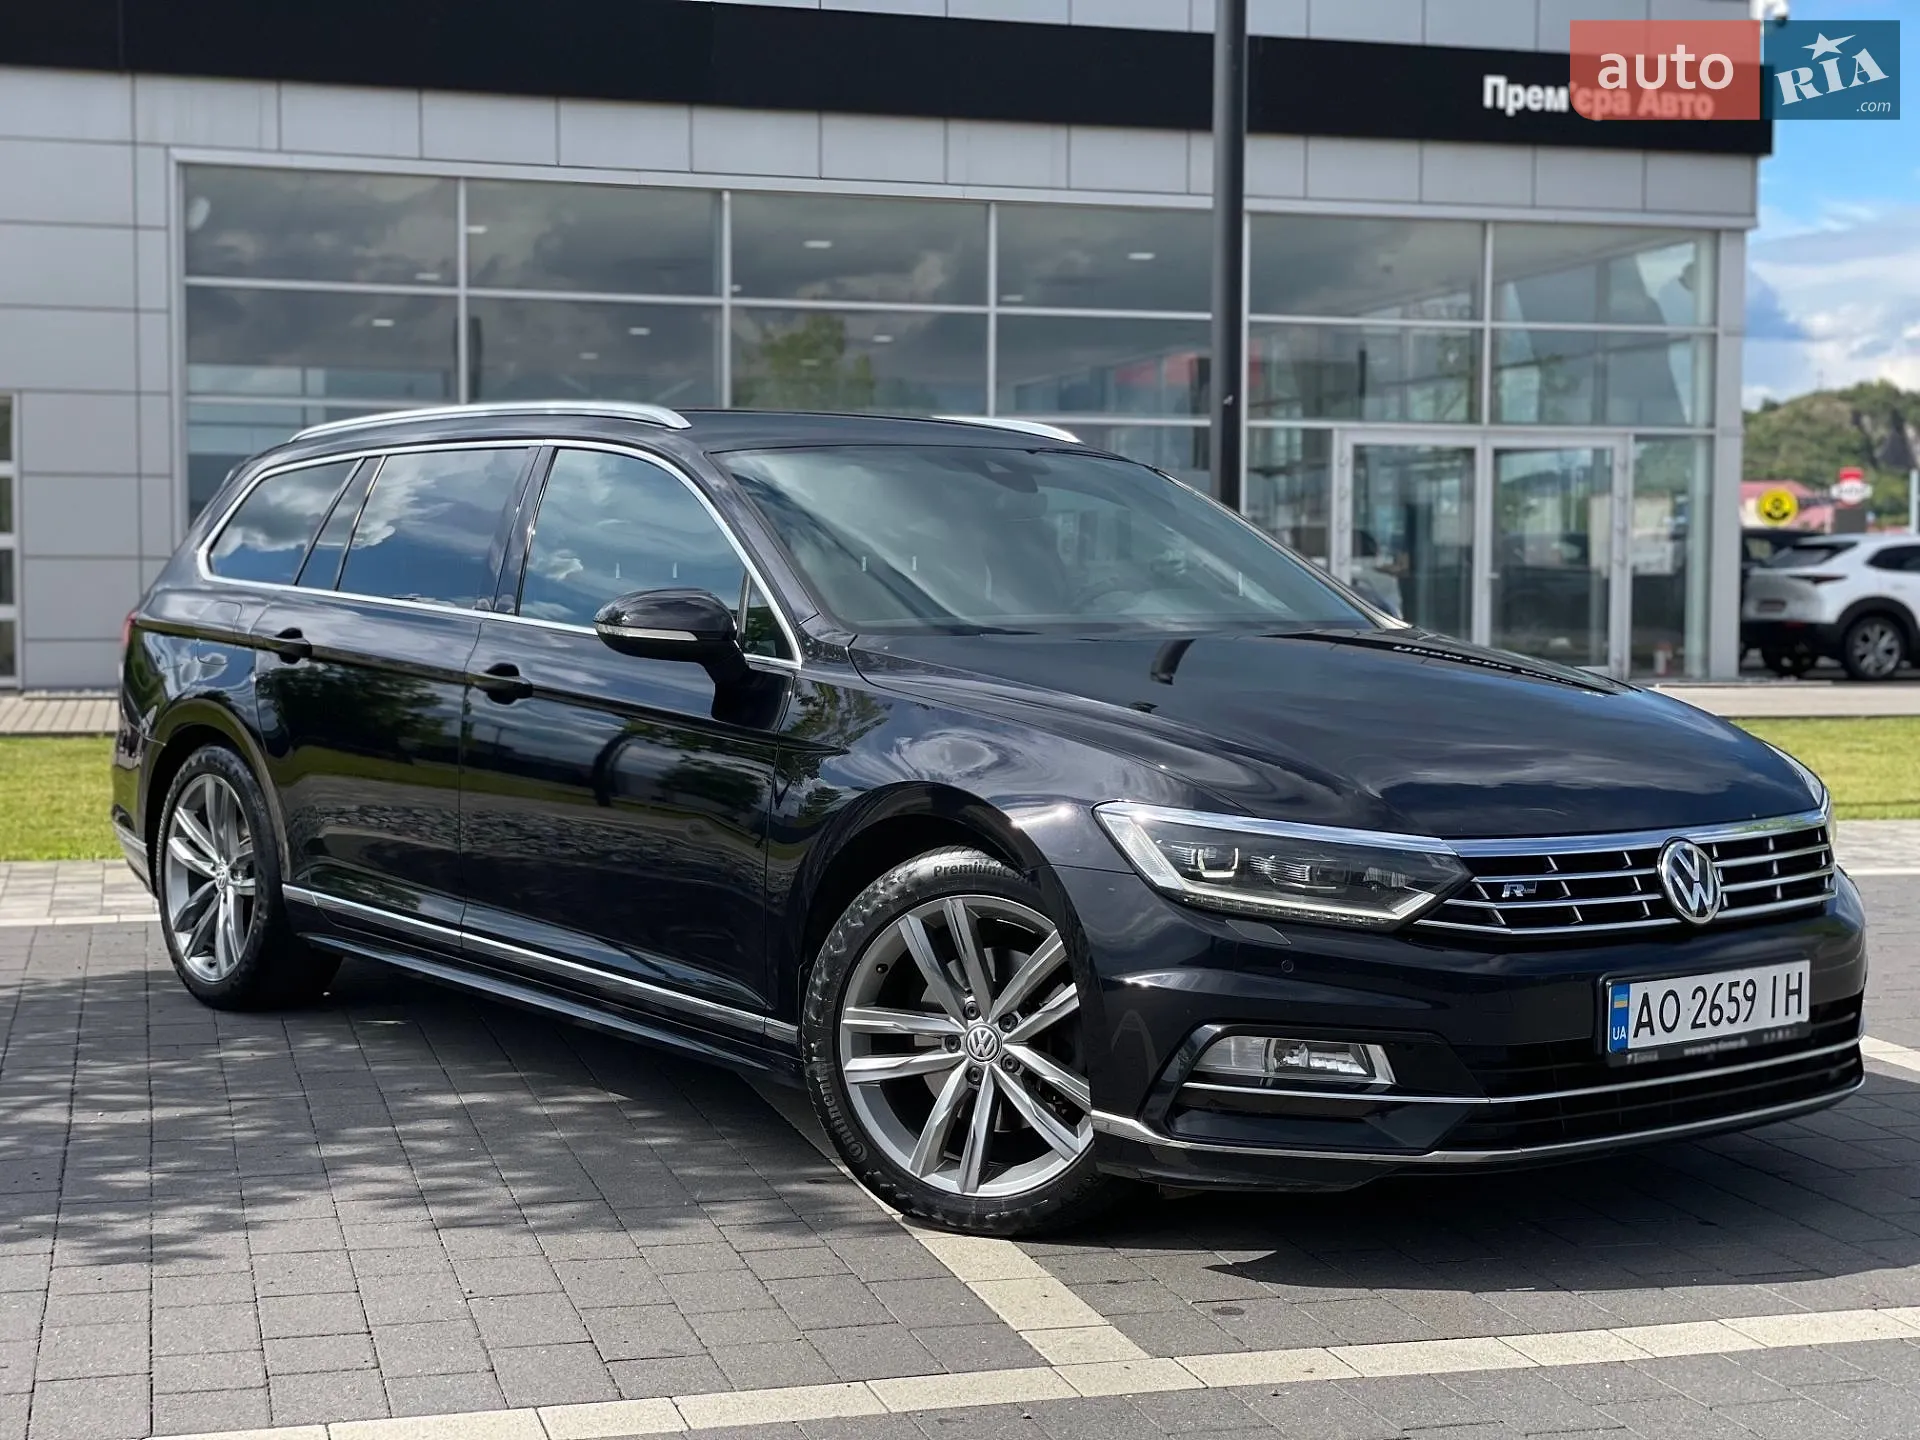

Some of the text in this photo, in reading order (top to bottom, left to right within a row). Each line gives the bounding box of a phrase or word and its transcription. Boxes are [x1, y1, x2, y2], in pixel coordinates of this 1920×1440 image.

[1636, 88, 1716, 119] Авто
[1633, 971, 1803, 1039] AO 2659 IH
[1612, 1026, 1627, 1041] UA
